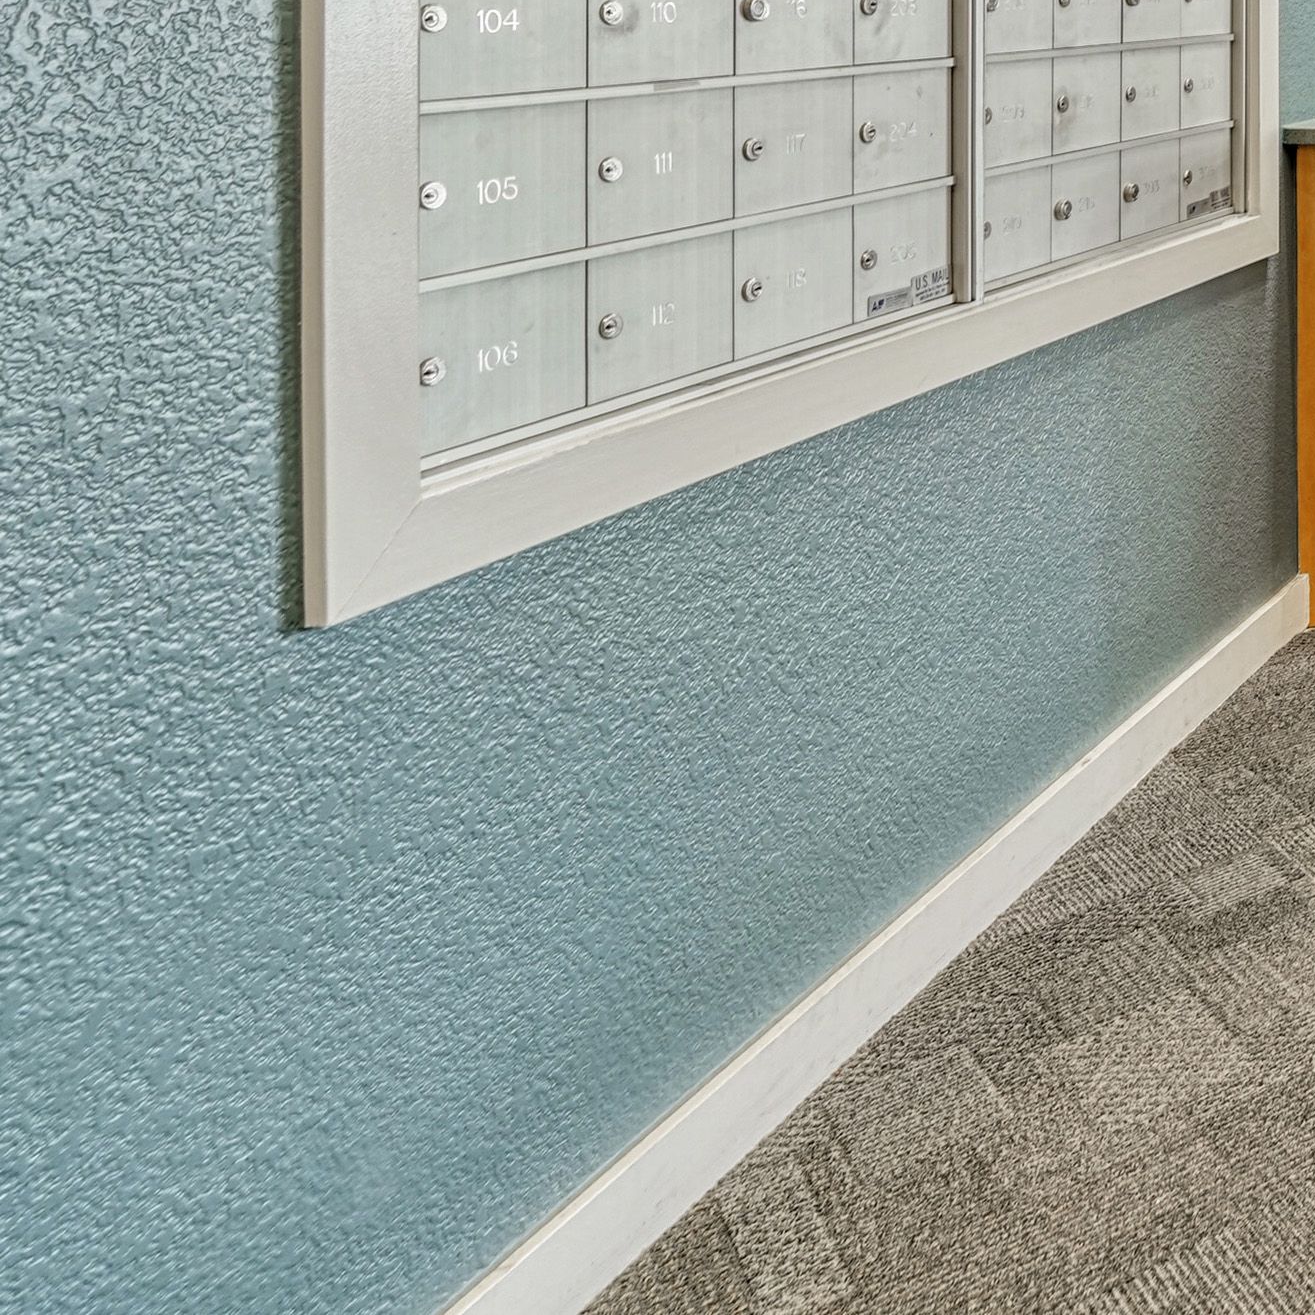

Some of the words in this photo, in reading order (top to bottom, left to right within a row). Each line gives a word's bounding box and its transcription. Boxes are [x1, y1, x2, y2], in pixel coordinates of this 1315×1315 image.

[476, 8, 520, 34] 104
[650, 1, 678, 24] 110
[653, 151, 674, 175] 111
[476, 176, 519, 205] 105
[651, 302, 676, 327] 112
[476, 342, 519, 373] 106
